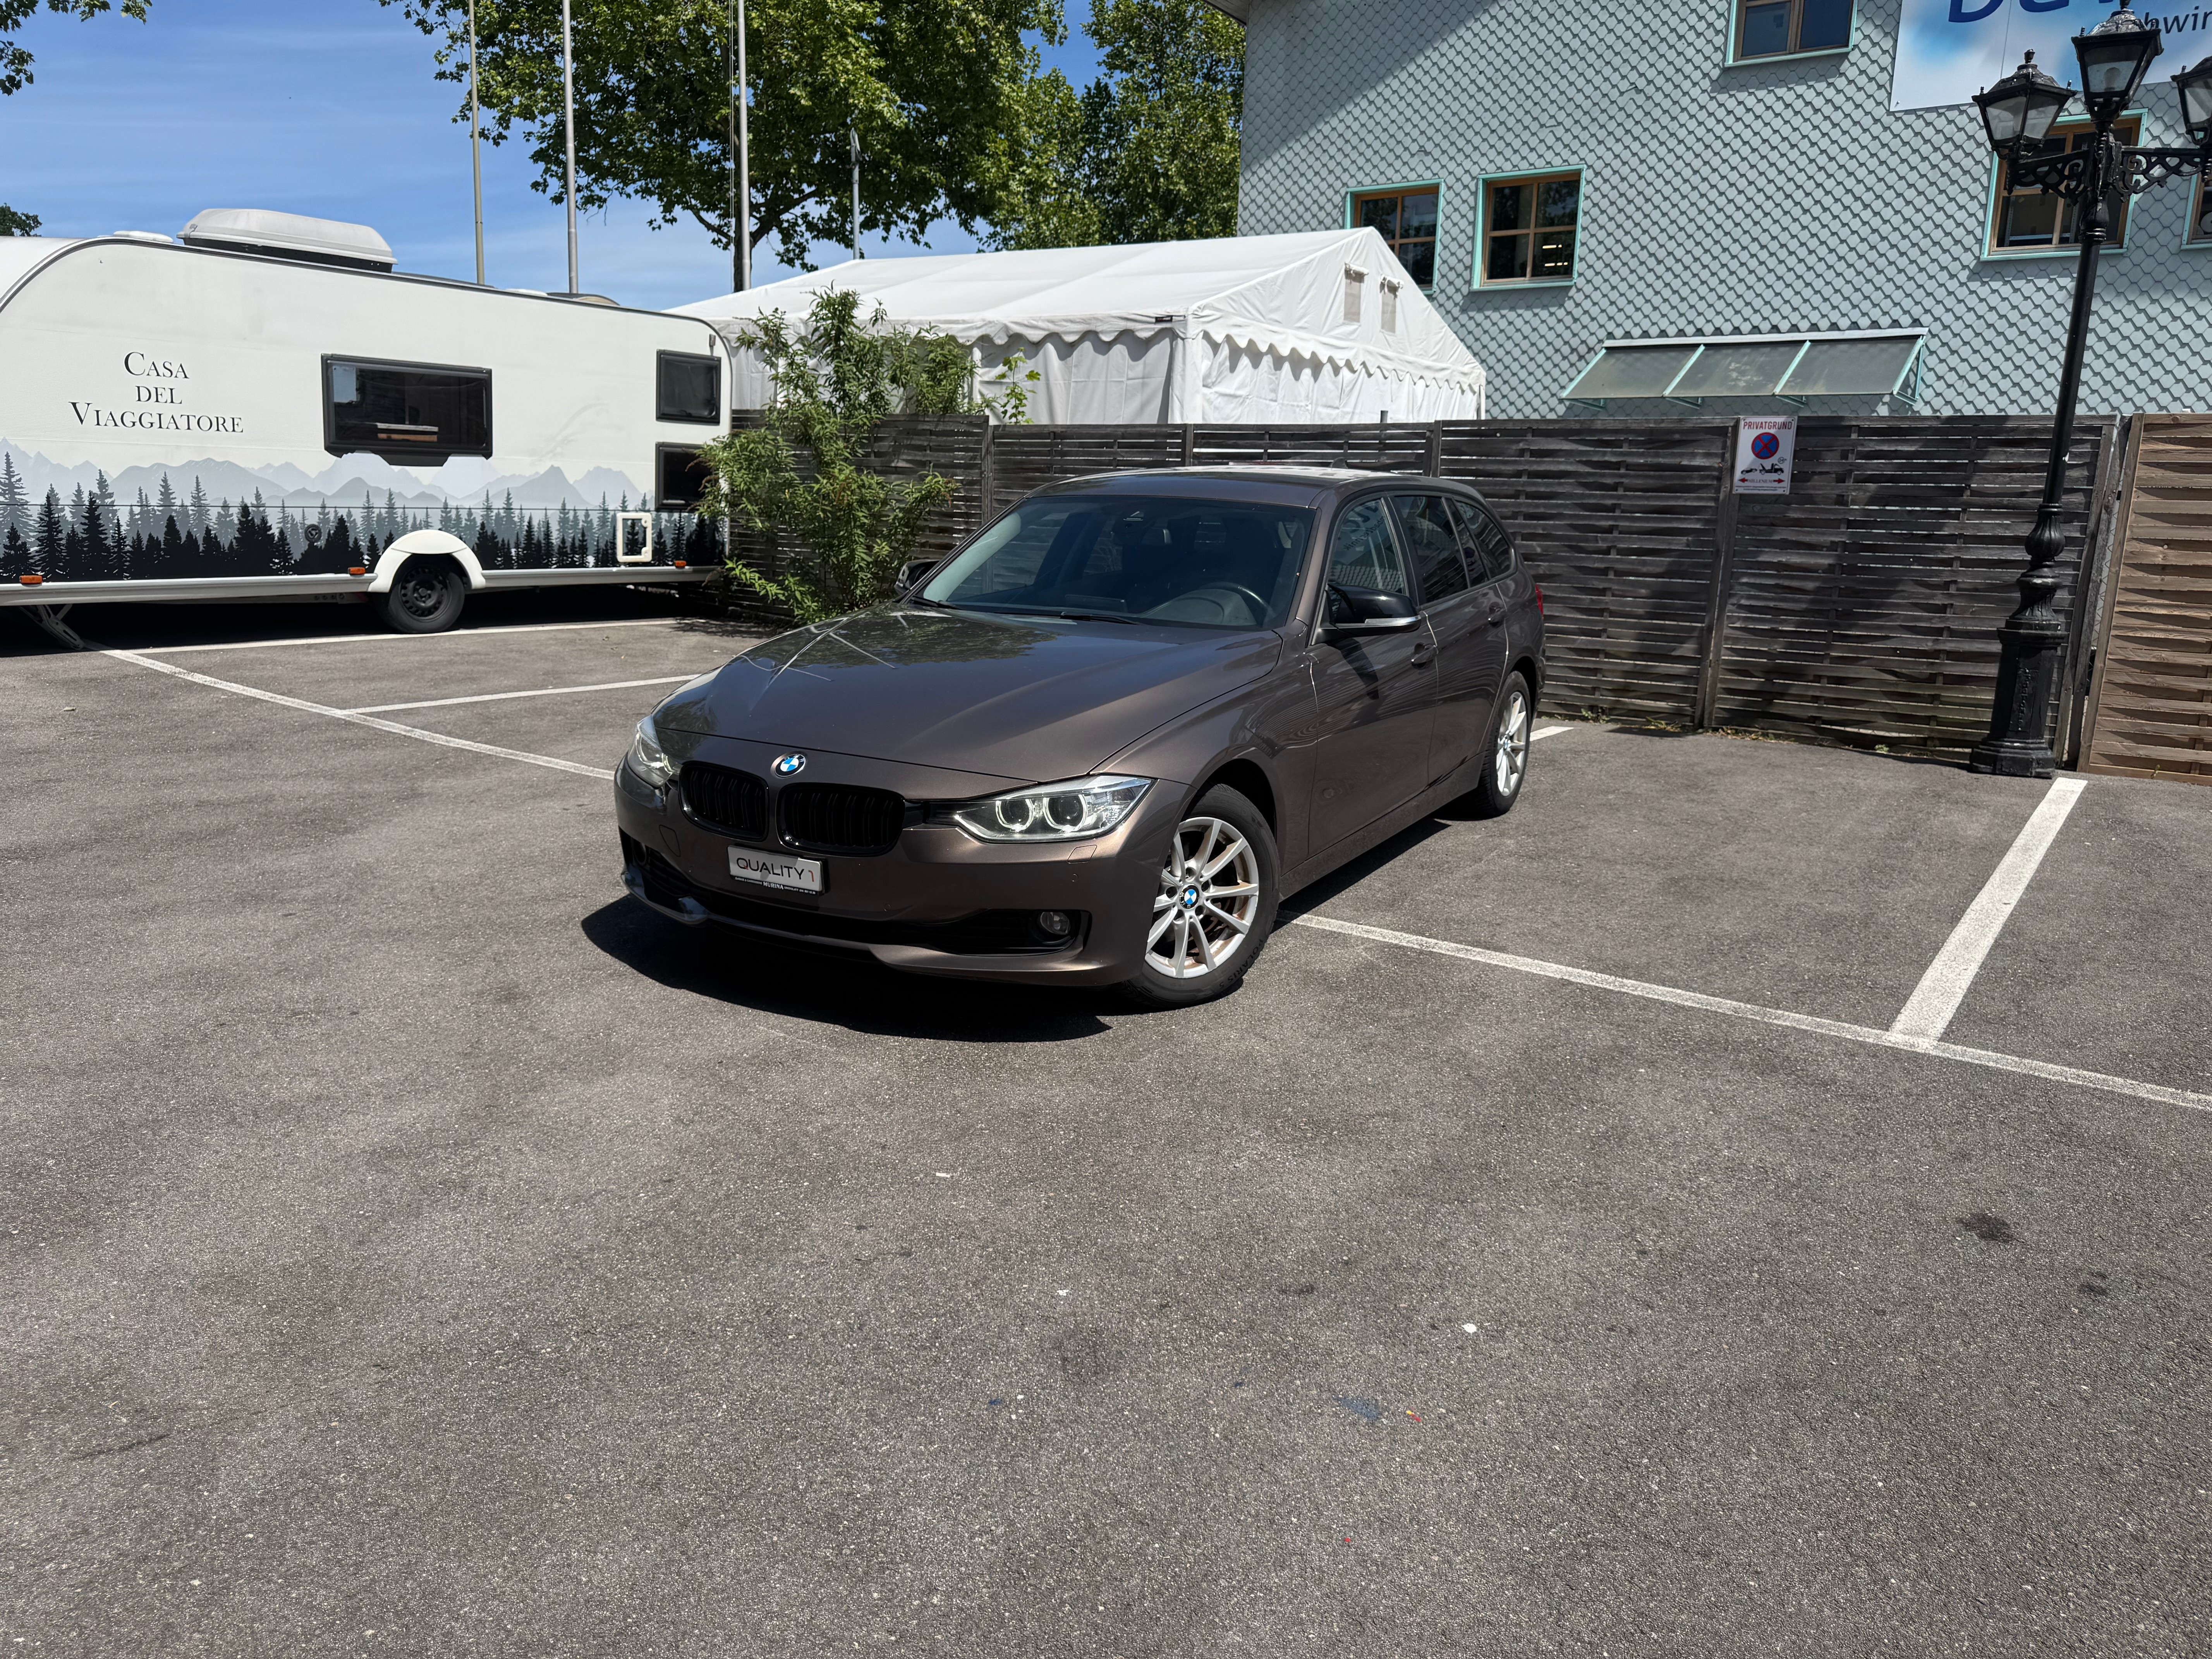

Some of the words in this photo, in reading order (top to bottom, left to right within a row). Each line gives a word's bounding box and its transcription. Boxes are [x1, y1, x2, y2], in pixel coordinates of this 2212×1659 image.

[135, 386, 182, 404] DEL
[68, 401, 244, 433] VIAGGIATORE
[1743, 421, 1792, 430] PRIVATGRUND
[737, 857, 804, 880] QUALITY
[808, 870, 814, 882] 1
[763, 881, 784, 890] MURINA
[1228, 939, 1263, 983] POLARIS
